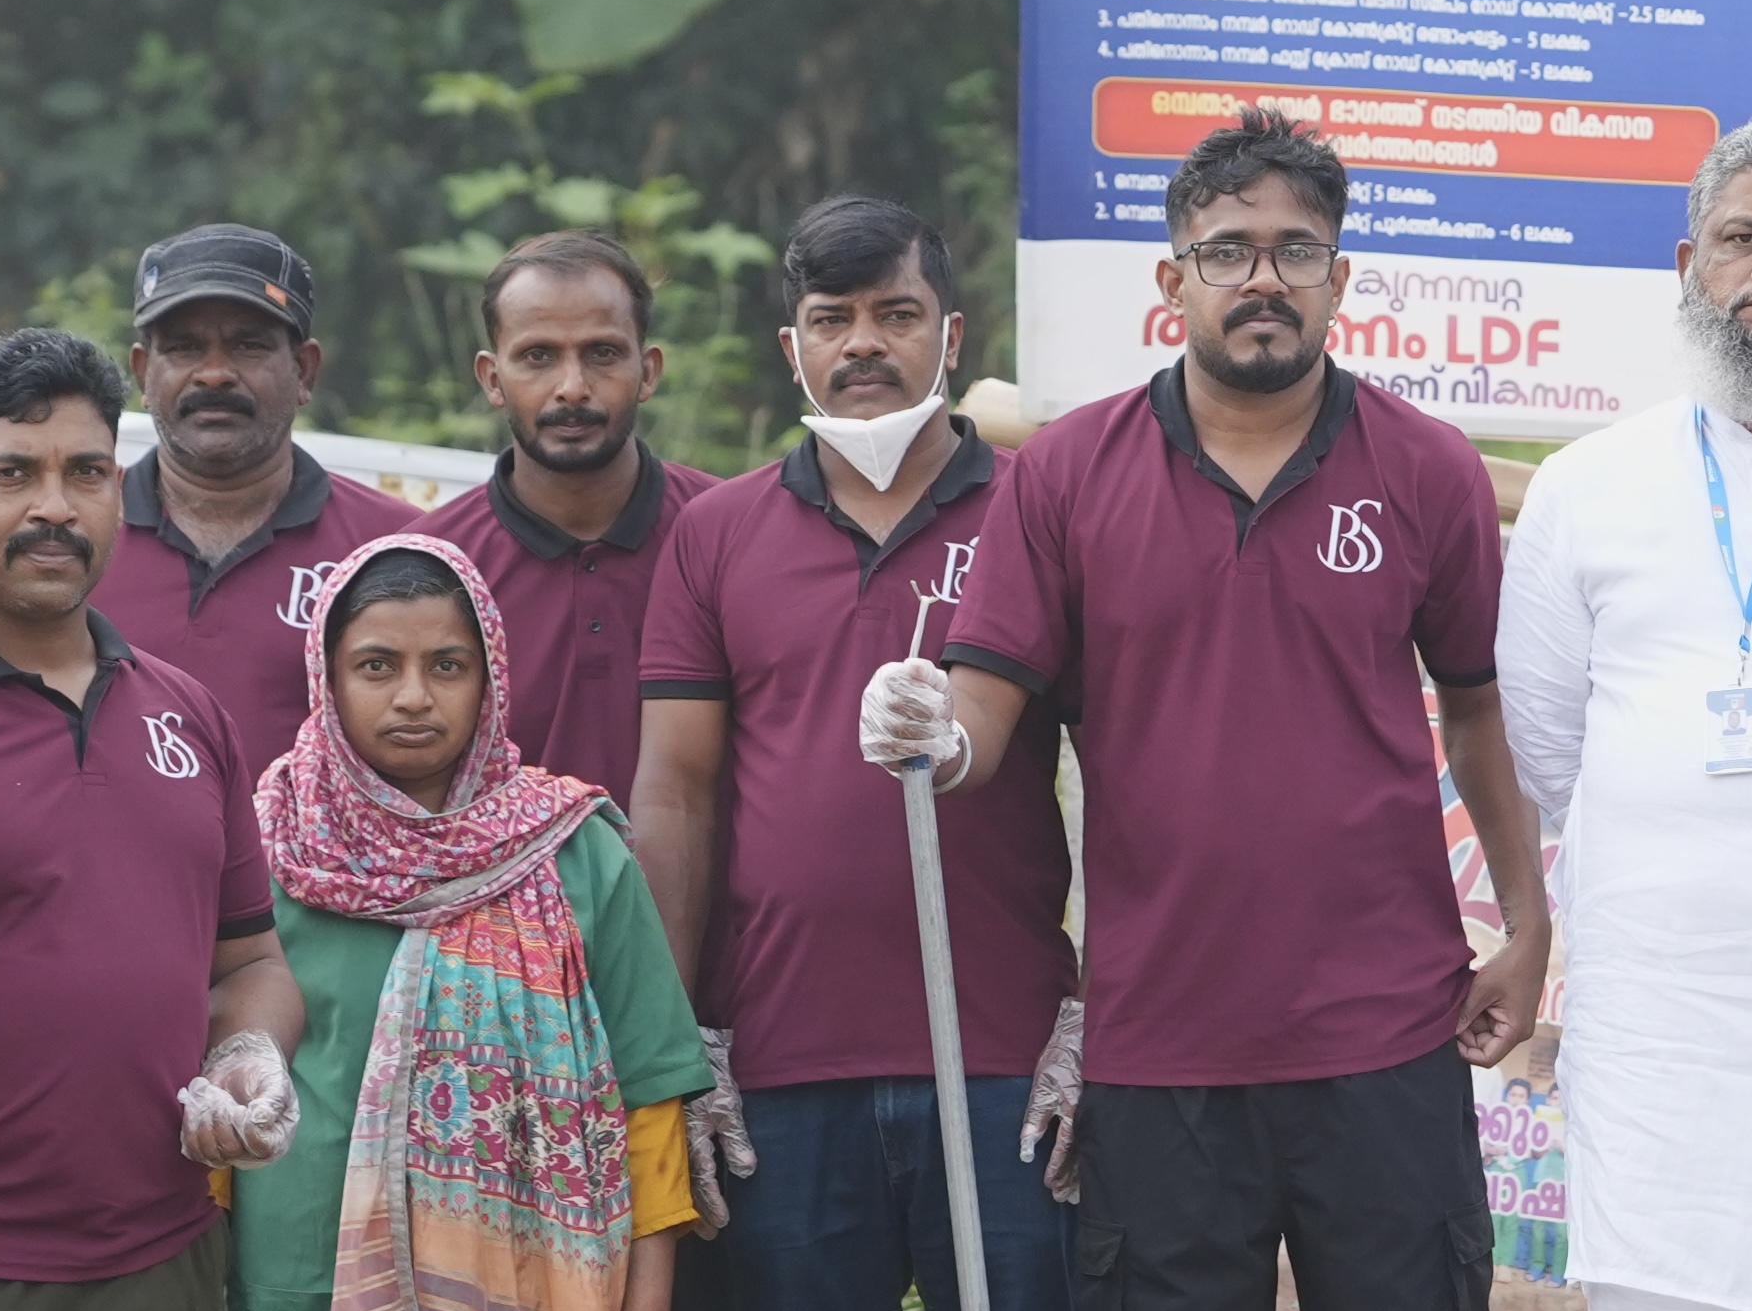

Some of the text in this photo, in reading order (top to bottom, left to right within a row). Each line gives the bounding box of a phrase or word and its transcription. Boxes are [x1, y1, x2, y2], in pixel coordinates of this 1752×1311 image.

[1355, 269, 1522, 312] കുന്നമ്പറ്റ
[1447, 315, 1559, 367] LDF
[1451, 365, 1620, 412] വികസനം
